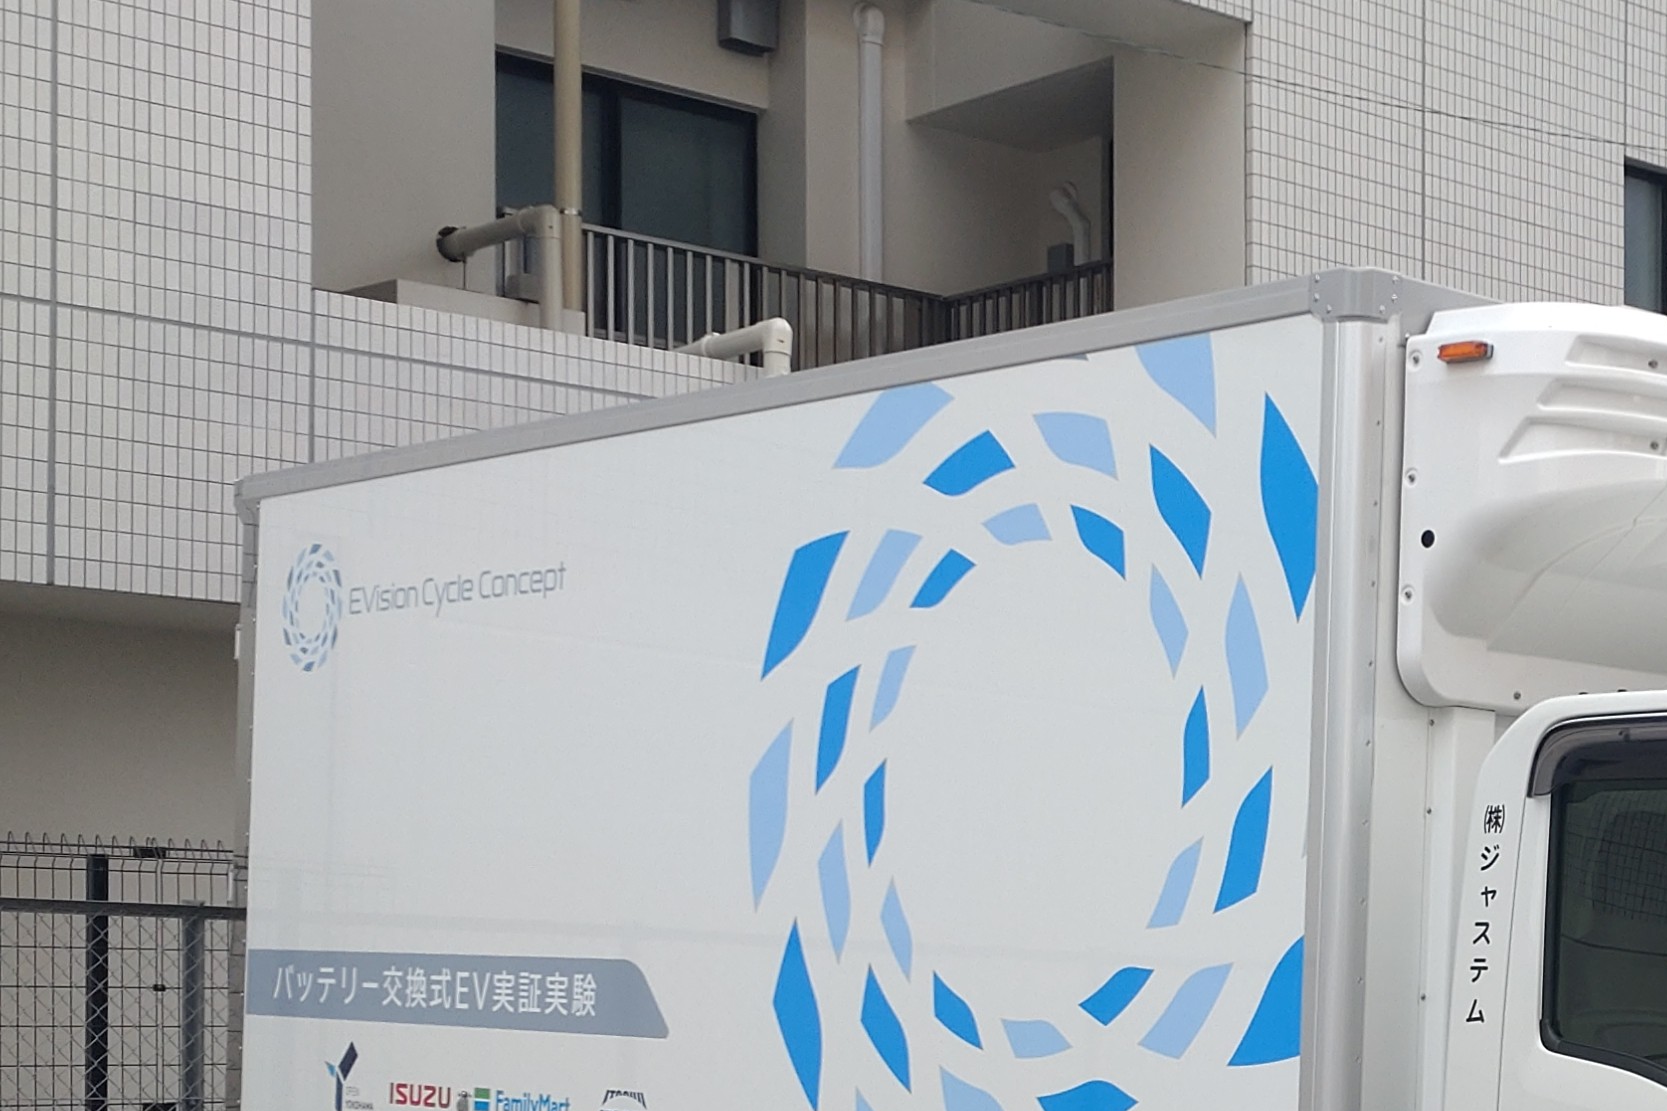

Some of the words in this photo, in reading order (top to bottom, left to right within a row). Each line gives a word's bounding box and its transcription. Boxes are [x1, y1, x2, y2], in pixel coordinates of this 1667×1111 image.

[349, 584, 418, 615] EVision
[422, 574, 474, 618] Cycle
[479, 561, 566, 599] Concept
[273, 965, 598, 1017] バッテリー交換式EV実証実験
[389, 1082, 451, 1109] ISUZU
